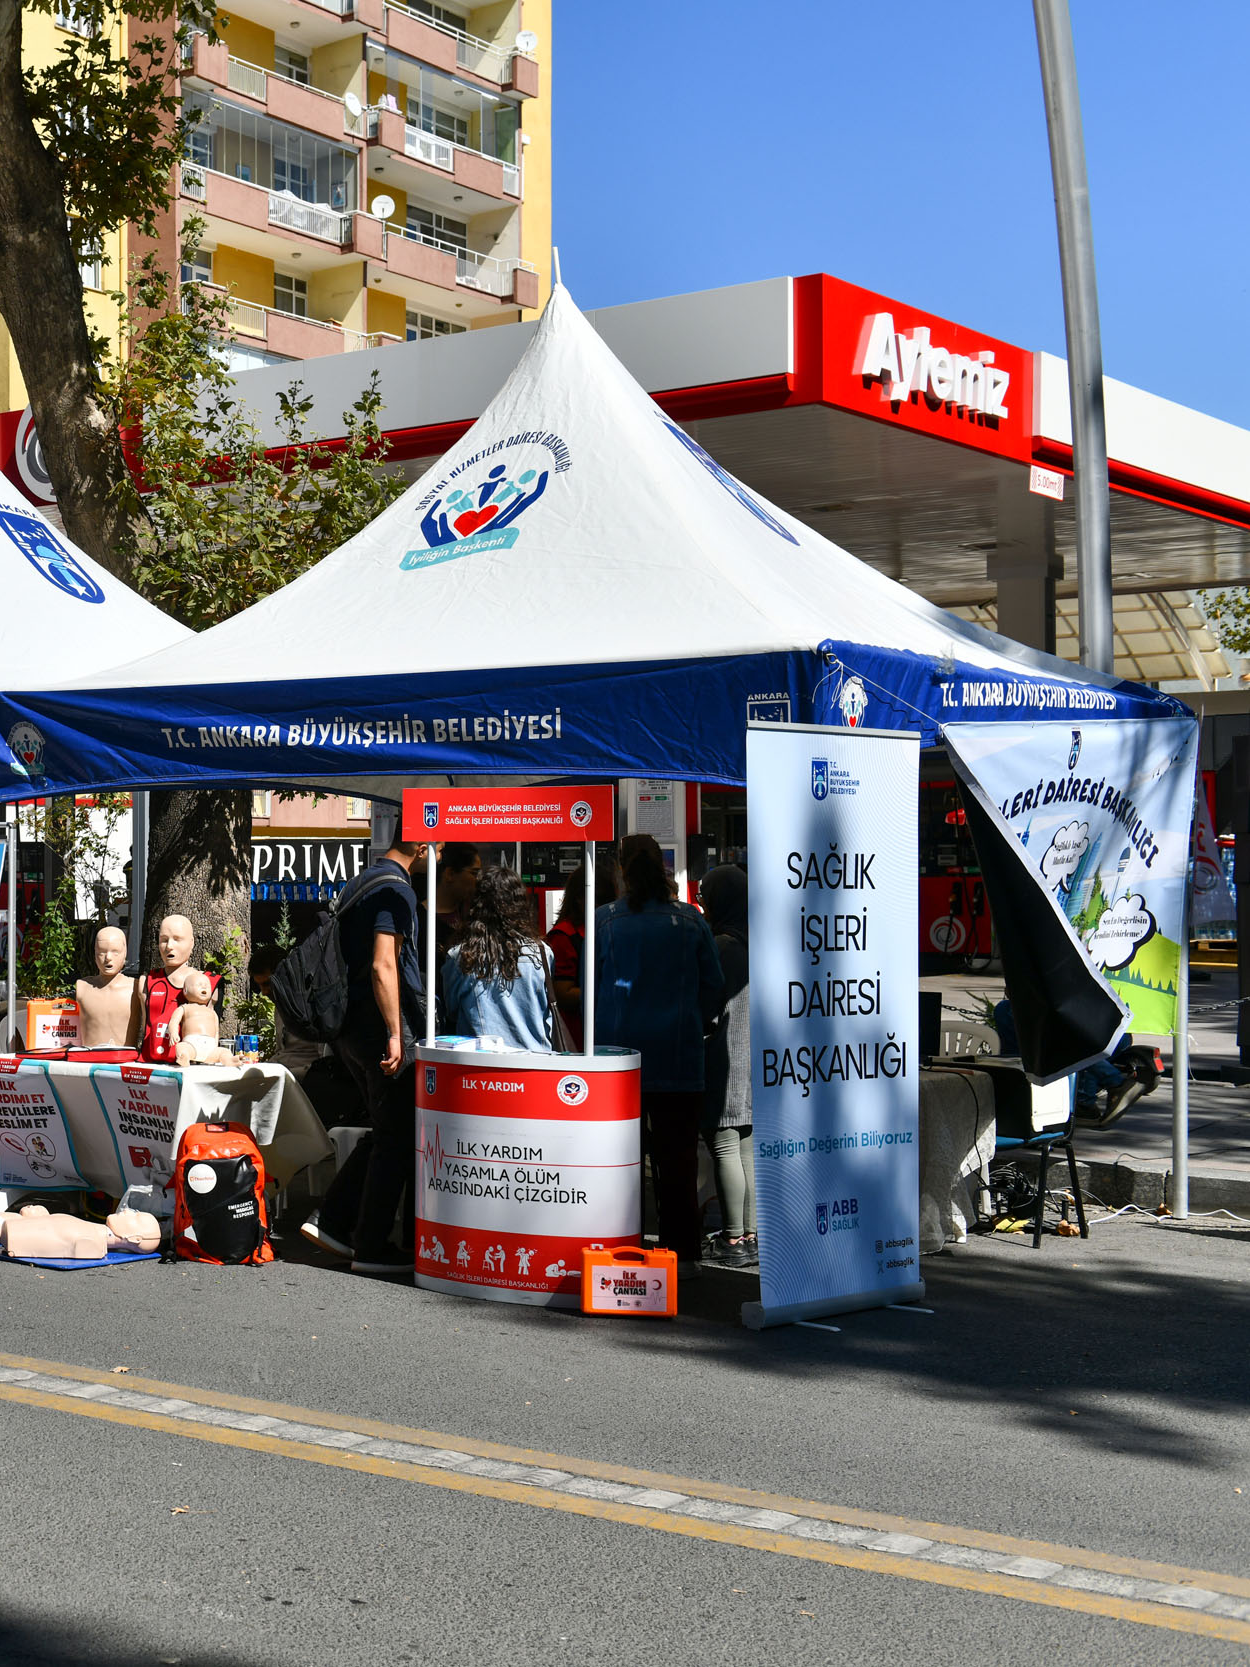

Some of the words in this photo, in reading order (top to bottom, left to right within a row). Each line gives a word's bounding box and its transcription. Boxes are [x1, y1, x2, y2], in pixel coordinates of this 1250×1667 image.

[858, 312, 1010, 419] Aytemiz
[415, 479, 450, 511] SOSYAL
[449, 440, 504, 479] HİZMETLER
[505, 430, 546, 448] DAİRESİ
[452, 535, 506, 554] Başkenti
[747, 692, 790, 701] ANKARA
[940, 683, 958, 707] T.C.
[962, 683, 1004, 706] ANKARA
[161, 727, 195, 748] T.C.
[199, 724, 281, 747] ANKARA
[286, 713, 426, 748] BÜYÜKŞEHİR
[432, 707, 561, 743] BELEDİYESİ
[448, 804, 477, 812] ANKARA
[478, 803, 522, 813] BÜYÜKŞEHİR
[523, 803, 561, 811] BELEDİYESİ
[445, 816, 470, 825] SAĞLIK
[471, 816, 493, 826] İŞLERİ
[494, 816, 521, 824] DAİRESİ
[522, 815, 563, 826] BAŞKANLIĞI
[1000, 779, 1043, 820] LERİ
[1043, 772, 1105, 806] DAİRESİ
[1101, 786, 1159, 868] BAŞKANLIĞI
[251, 844, 364, 886] PRIME
[787, 842, 876, 890] SAĞLIK
[800, 907, 868, 965] İŞLERİ
[788, 971, 881, 1019] DAİRESİ
[762, 1032, 907, 1097] BAŞKANLIĞI
[128, 1086, 150, 1101] İLK
[462, 1076, 479, 1090] İLK
[480, 1079, 524, 1093] YARDIM
[31, 1093, 45, 1103] ET
[118, 1099, 169, 1117] YARDIM
[34, 1119, 48, 1128] ET
[118, 1108, 175, 1131] İNSANLIK
[119, 1122, 174, 1143] GÖREVİDİ
[456, 1138, 477, 1156] İLK
[481, 1144, 543, 1161] YARDIM
[759, 1137, 807, 1160] Sağlığın
[808, 1133, 859, 1156] Değerini
[861, 1130, 913, 1152] Biliyoruz
[444, 1162, 510, 1183] YAŞAMLA
[514, 1166, 560, 1185] ÖLÜM
[428, 1178, 510, 1200] ARASINDAKİ
[514, 1187, 588, 1205] ÇİZGİDİR
[832, 1198, 858, 1216] ABB
[832, 1217, 860, 1231] SAĞLIK
[446, 1271, 465, 1280] SAĞLIK
[466, 1274, 483, 1282] İŞLERİ
[484, 1276, 507, 1286] DAİRESİ
[509, 1280, 549, 1289] BAŞKANLIĞI
[613, 1279, 646, 1288] YARDIM
[622, 1270, 637, 1280] İLK
[613, 1287, 646, 1296] ÇANTASI
